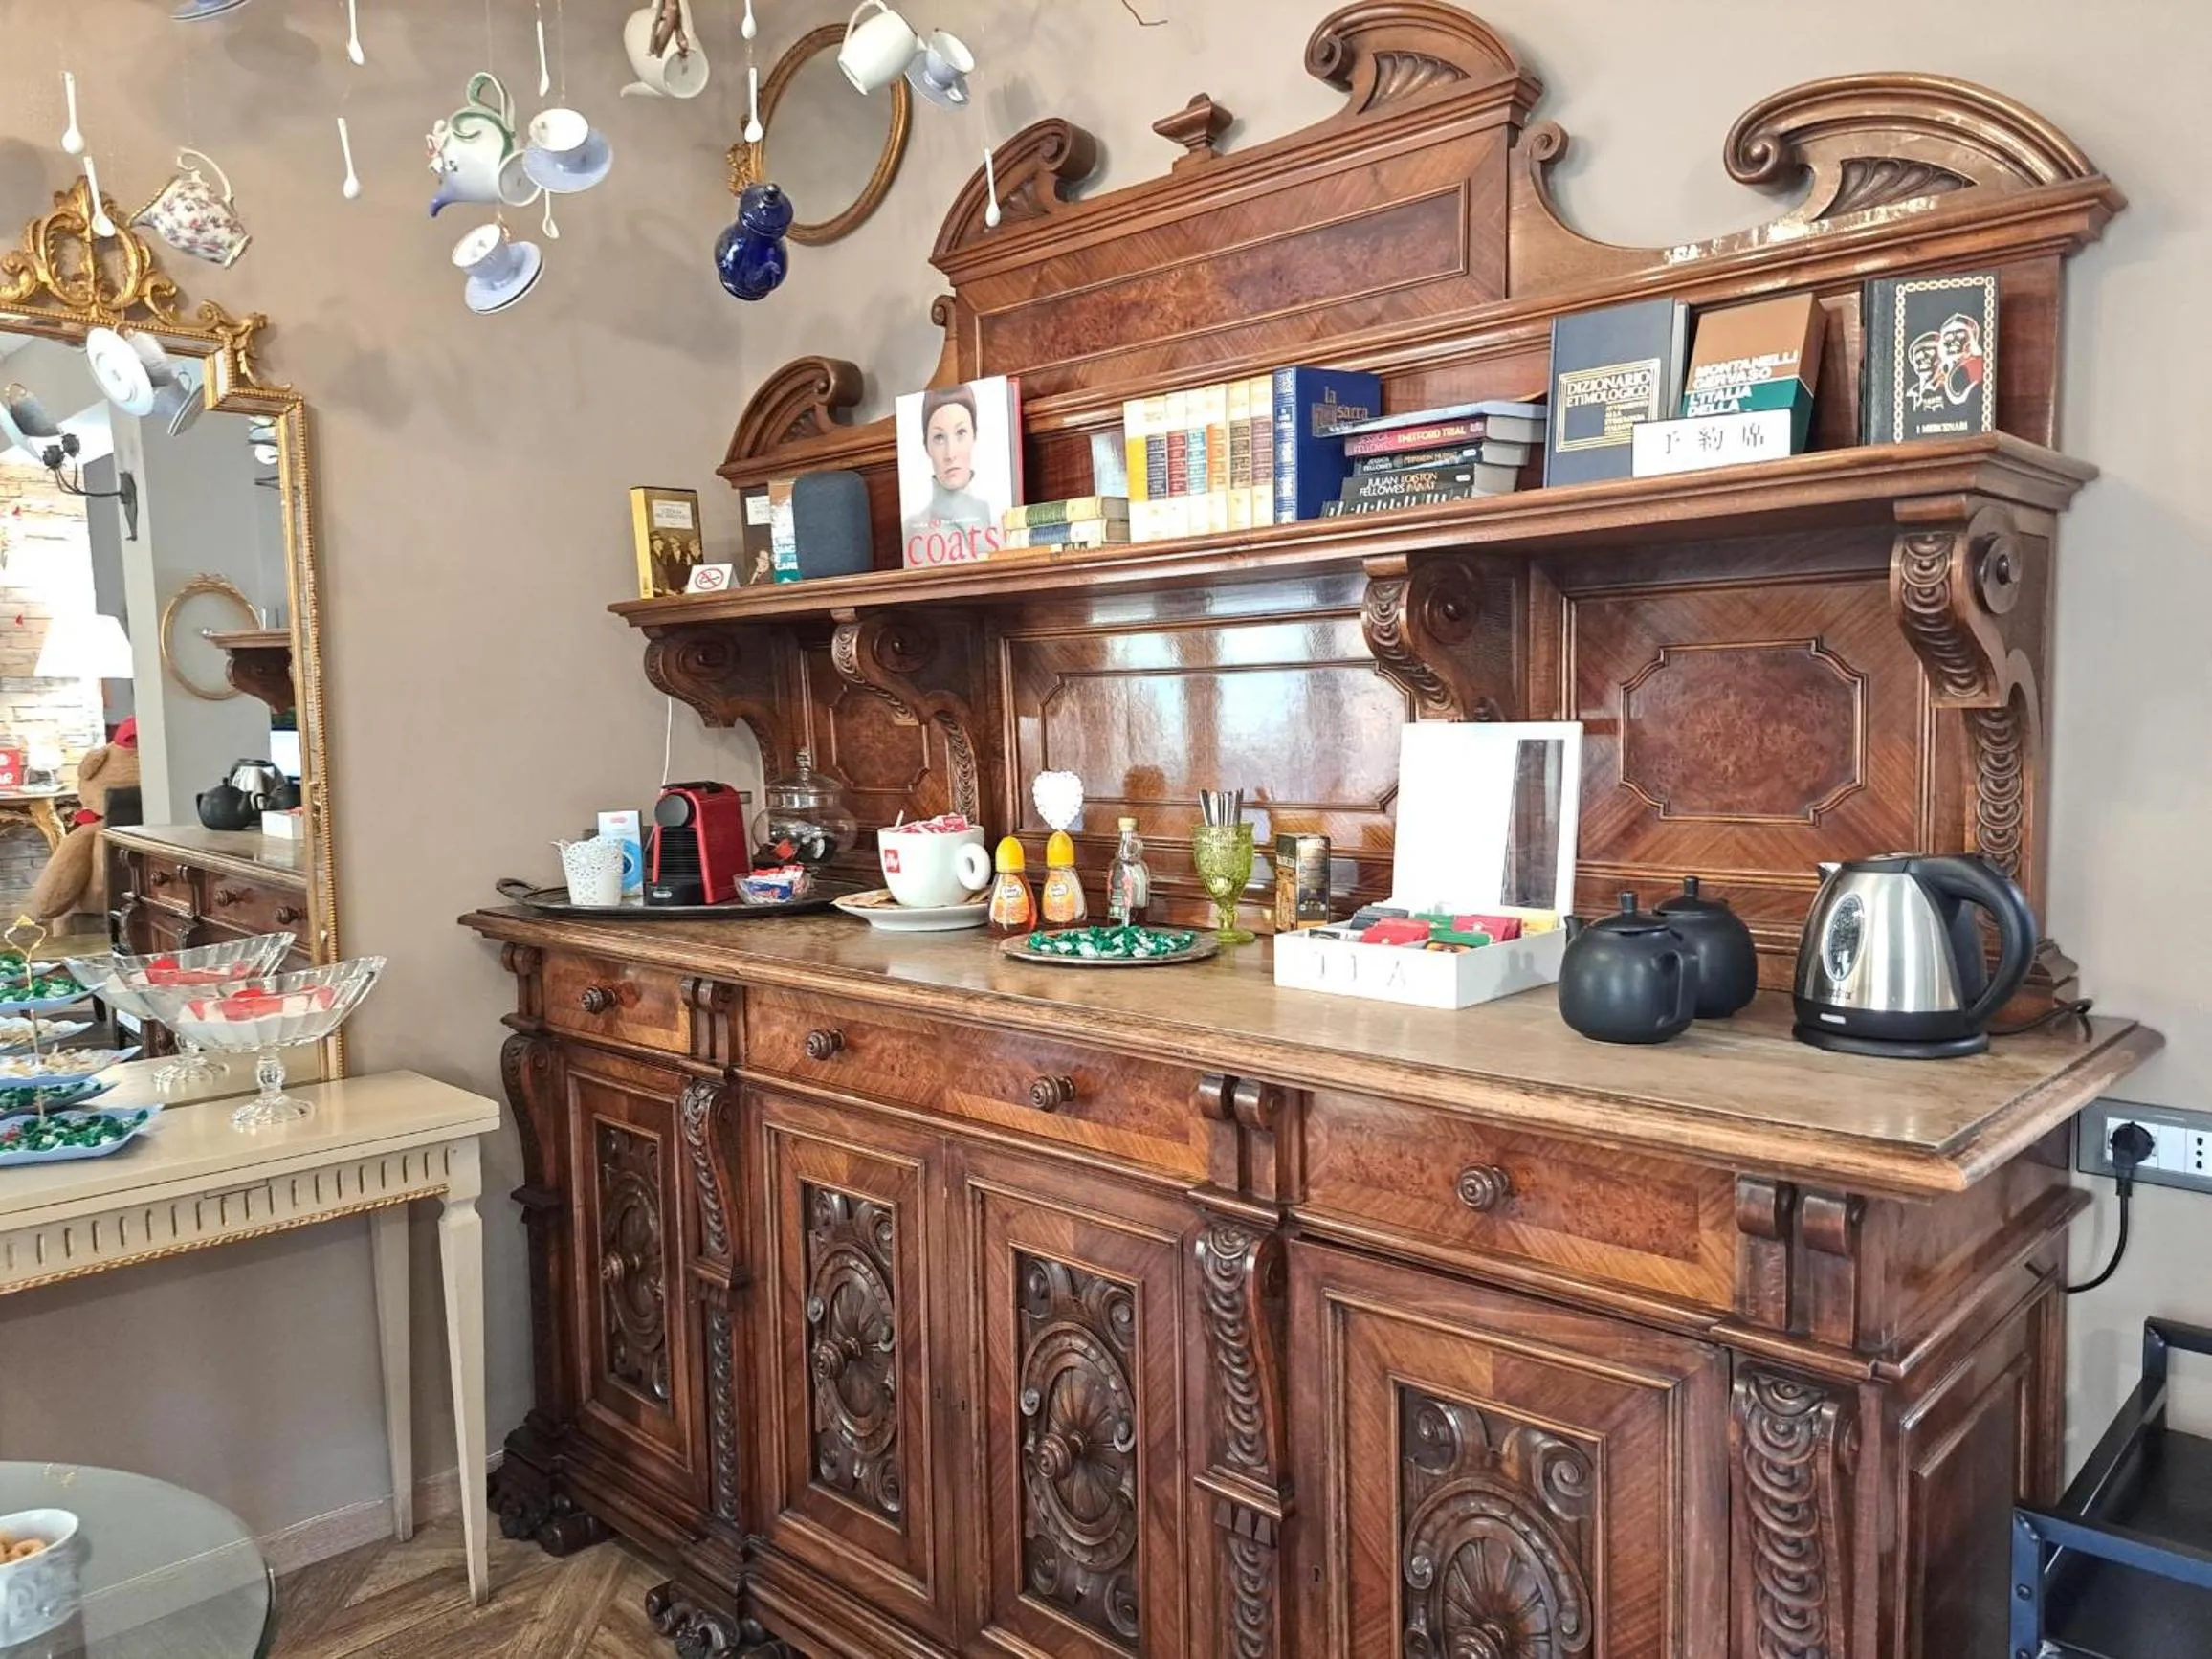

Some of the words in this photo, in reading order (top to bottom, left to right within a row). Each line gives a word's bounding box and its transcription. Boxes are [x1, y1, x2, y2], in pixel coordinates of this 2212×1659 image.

[1695, 349, 1799, 377] MONTANELLI
[1568, 371, 1650, 395] DIZIONARIO
[1693, 367, 1772, 389] GERVASO
[1567, 385, 1649, 408] ETIMOLOGICO
[1689, 385, 1752, 406] L'ITALIA
[1687, 399, 1741, 418] DELLA
[1359, 484, 1405, 497] FELLOWES
[1367, 476, 1400, 490] JULIAN
